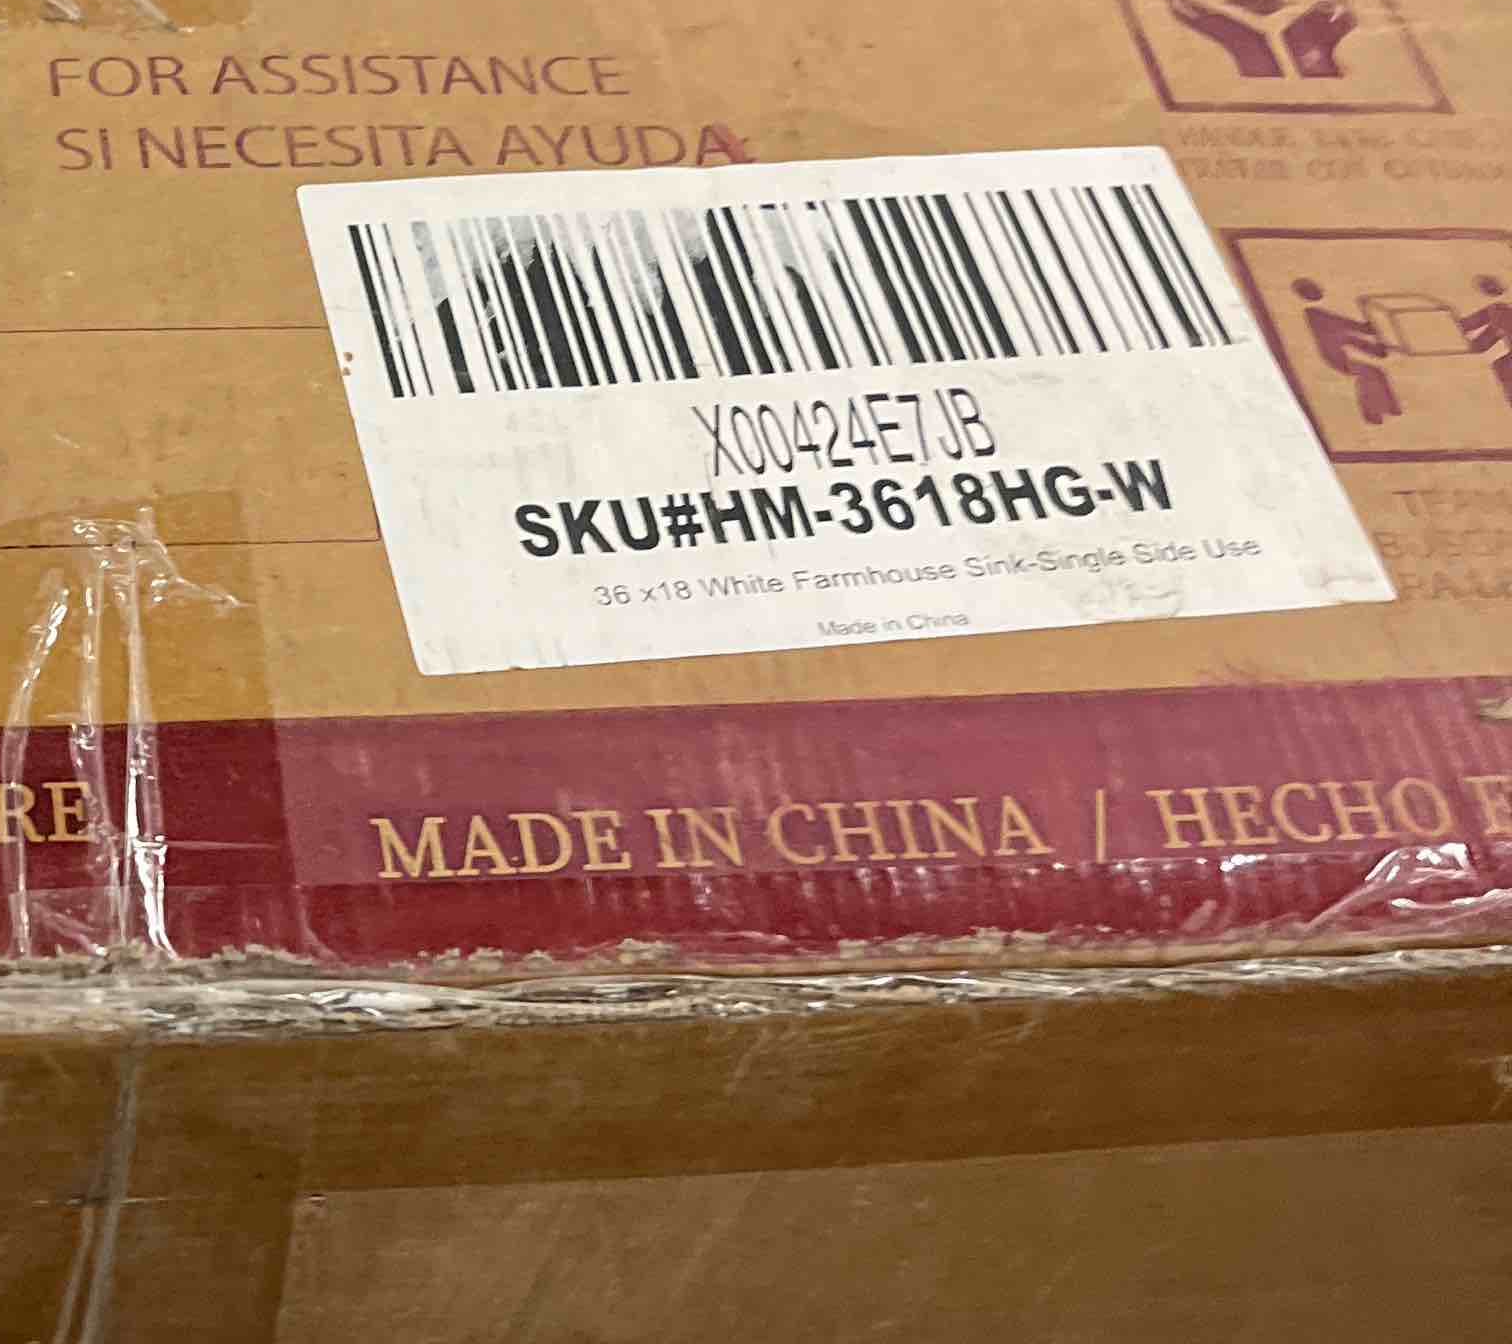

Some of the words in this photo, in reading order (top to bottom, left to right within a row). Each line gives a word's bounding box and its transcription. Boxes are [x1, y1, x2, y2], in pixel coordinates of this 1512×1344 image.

[48, 56, 190, 98] FOR
[210, 54, 632, 97] ASSISTANCE
[56, 127, 113, 171] SI
[137, 123, 474, 169] NECESITA
[691, 386, 997, 478] X00424E7JB
[514, 457, 1173, 560] SKU#HM-3618HG-W
[594, 583, 632, 608] 36
[640, 581, 692, 605] x18
[698, 572, 787, 601] White
[792, 558, 957, 594] Farmhouse
[965, 548, 1128, 582] Sink-Single
[1133, 539, 1198, 566] Side
[1202, 536, 1262, 560] Use
[817, 614, 876, 637] Made
[881, 615, 903, 633] in
[906, 610, 969, 632] China
[370, 808, 634, 880] MADE
[650, 804, 745, 870] IN
[768, 793, 1050, 866] CHINA
[1146, 775, 1454, 850] HECHO
